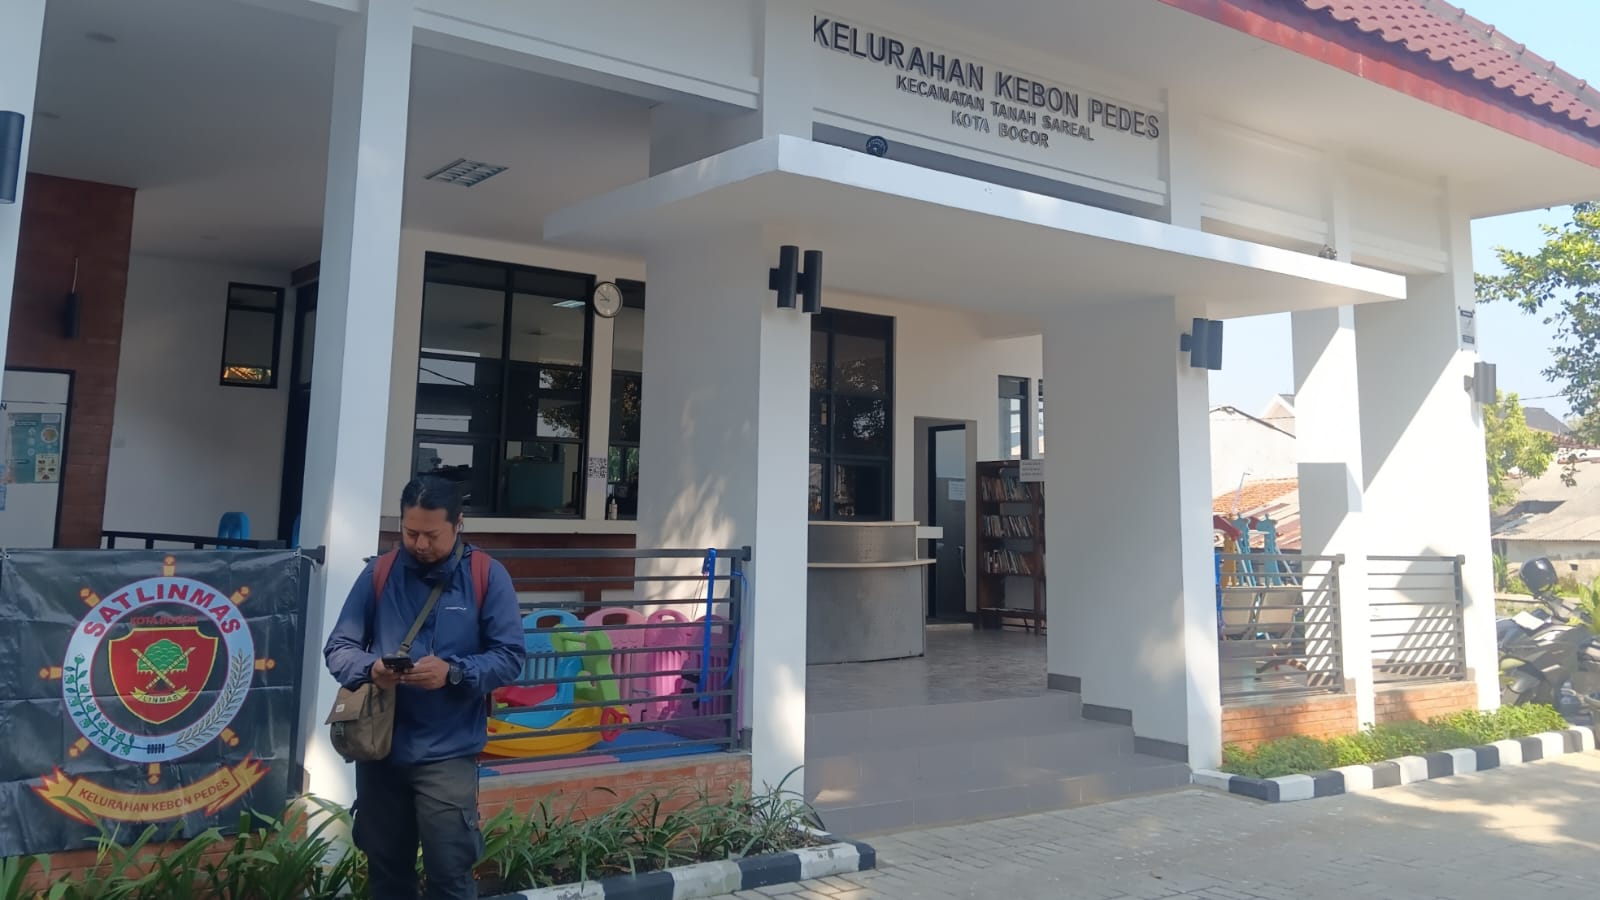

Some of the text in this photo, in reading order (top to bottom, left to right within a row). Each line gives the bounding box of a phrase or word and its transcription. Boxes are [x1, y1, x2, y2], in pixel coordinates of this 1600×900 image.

[813, 15, 1160, 139] KELURAHAN KEBON PEDES
[896, 74, 1095, 141] KECAMATAN TANAH SAREAL
[952, 110, 1049, 148] KOTA BOGOR
[83, 583, 241, 637] SATLINMAS
[131, 615, 157, 625] KOTA
[78, 778, 230, 812] KELURAHAN KEBON PEDES
